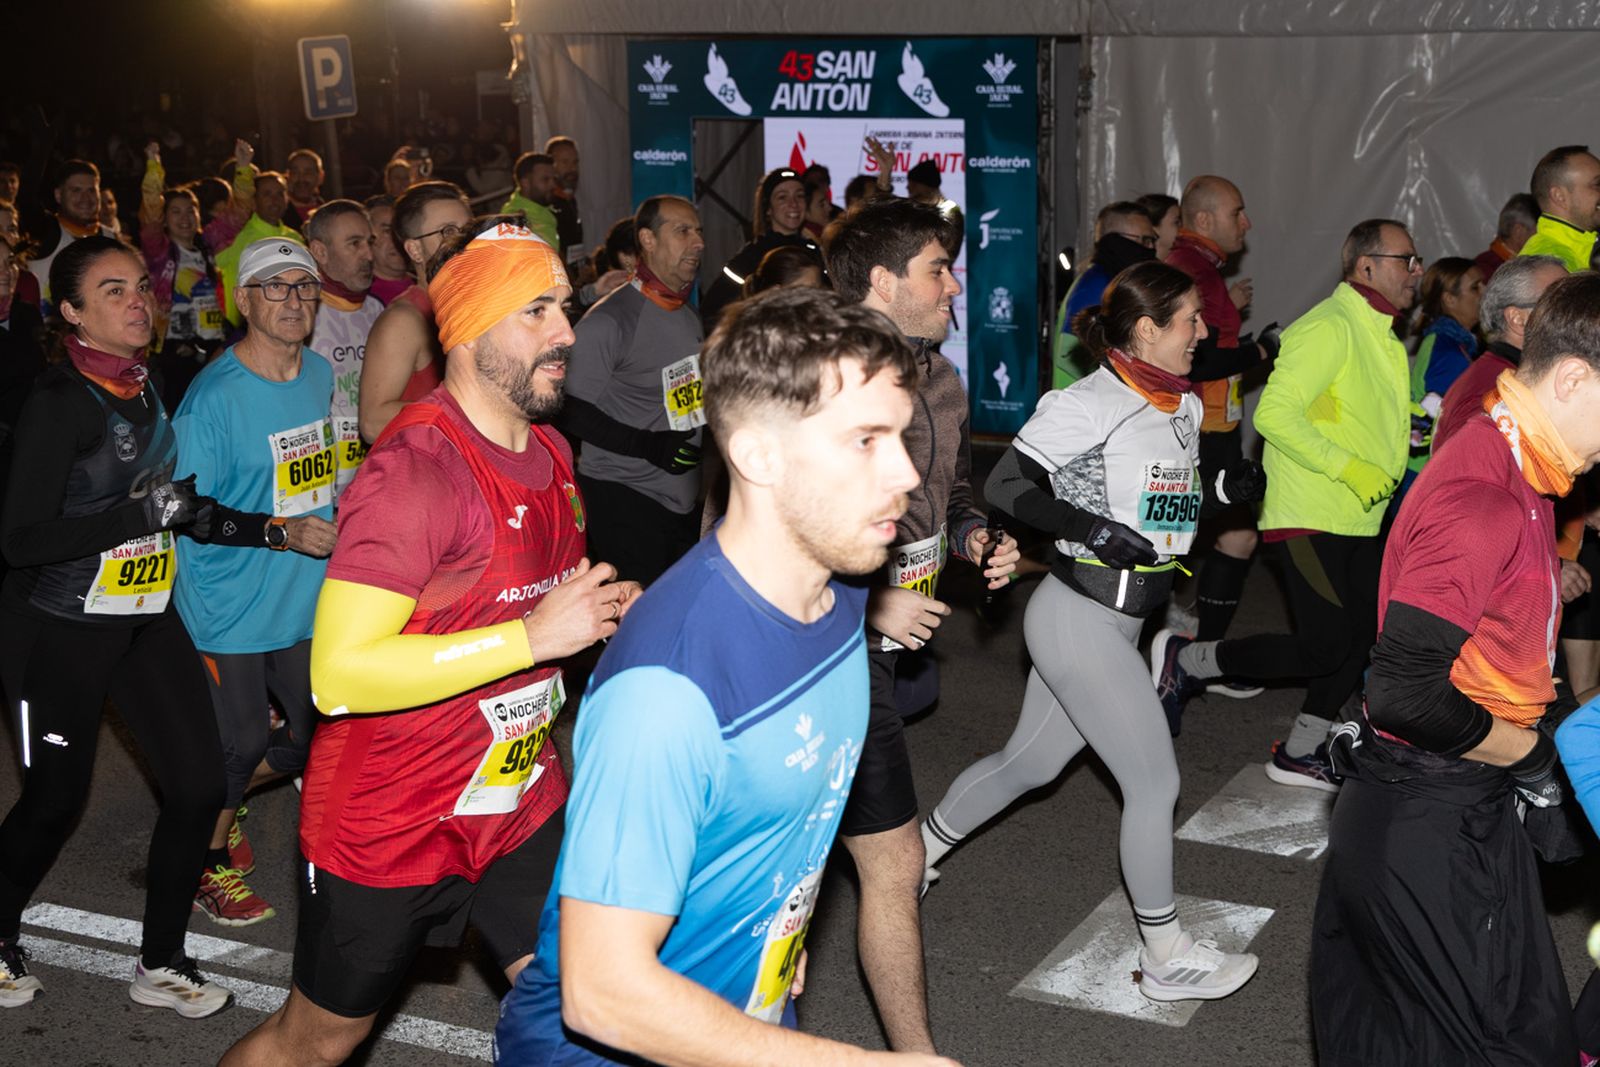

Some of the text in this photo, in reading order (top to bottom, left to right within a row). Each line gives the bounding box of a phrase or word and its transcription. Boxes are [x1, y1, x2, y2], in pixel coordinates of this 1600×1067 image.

[312, 46, 343, 110] P
[718, 83, 736, 104] 43
[770, 75, 871, 112] ANTÓN
[913, 84, 933, 105] 43
[633, 149, 687, 162] calderón
[864, 152, 911, 173] SN
[968, 155, 1031, 168] calderón
[290, 435, 310, 448] NOCHE
[310, 431, 319, 441] DE
[282, 450, 298, 462] SAN
[289, 449, 333, 487] 6062
[1161, 471, 1184, 480] NOCHE
[1183, 471, 1190, 481] DE
[1148, 481, 1165, 492] SAN
[1145, 494, 1200, 523] 13596
[111, 548, 132, 559] SAN
[909, 551, 931, 567] NOCHE
[118, 553, 168, 587] 9227
[900, 569, 917, 584] SAN
[496, 574, 559, 603] ARJONILLA
[505, 722, 524, 741] SAN
